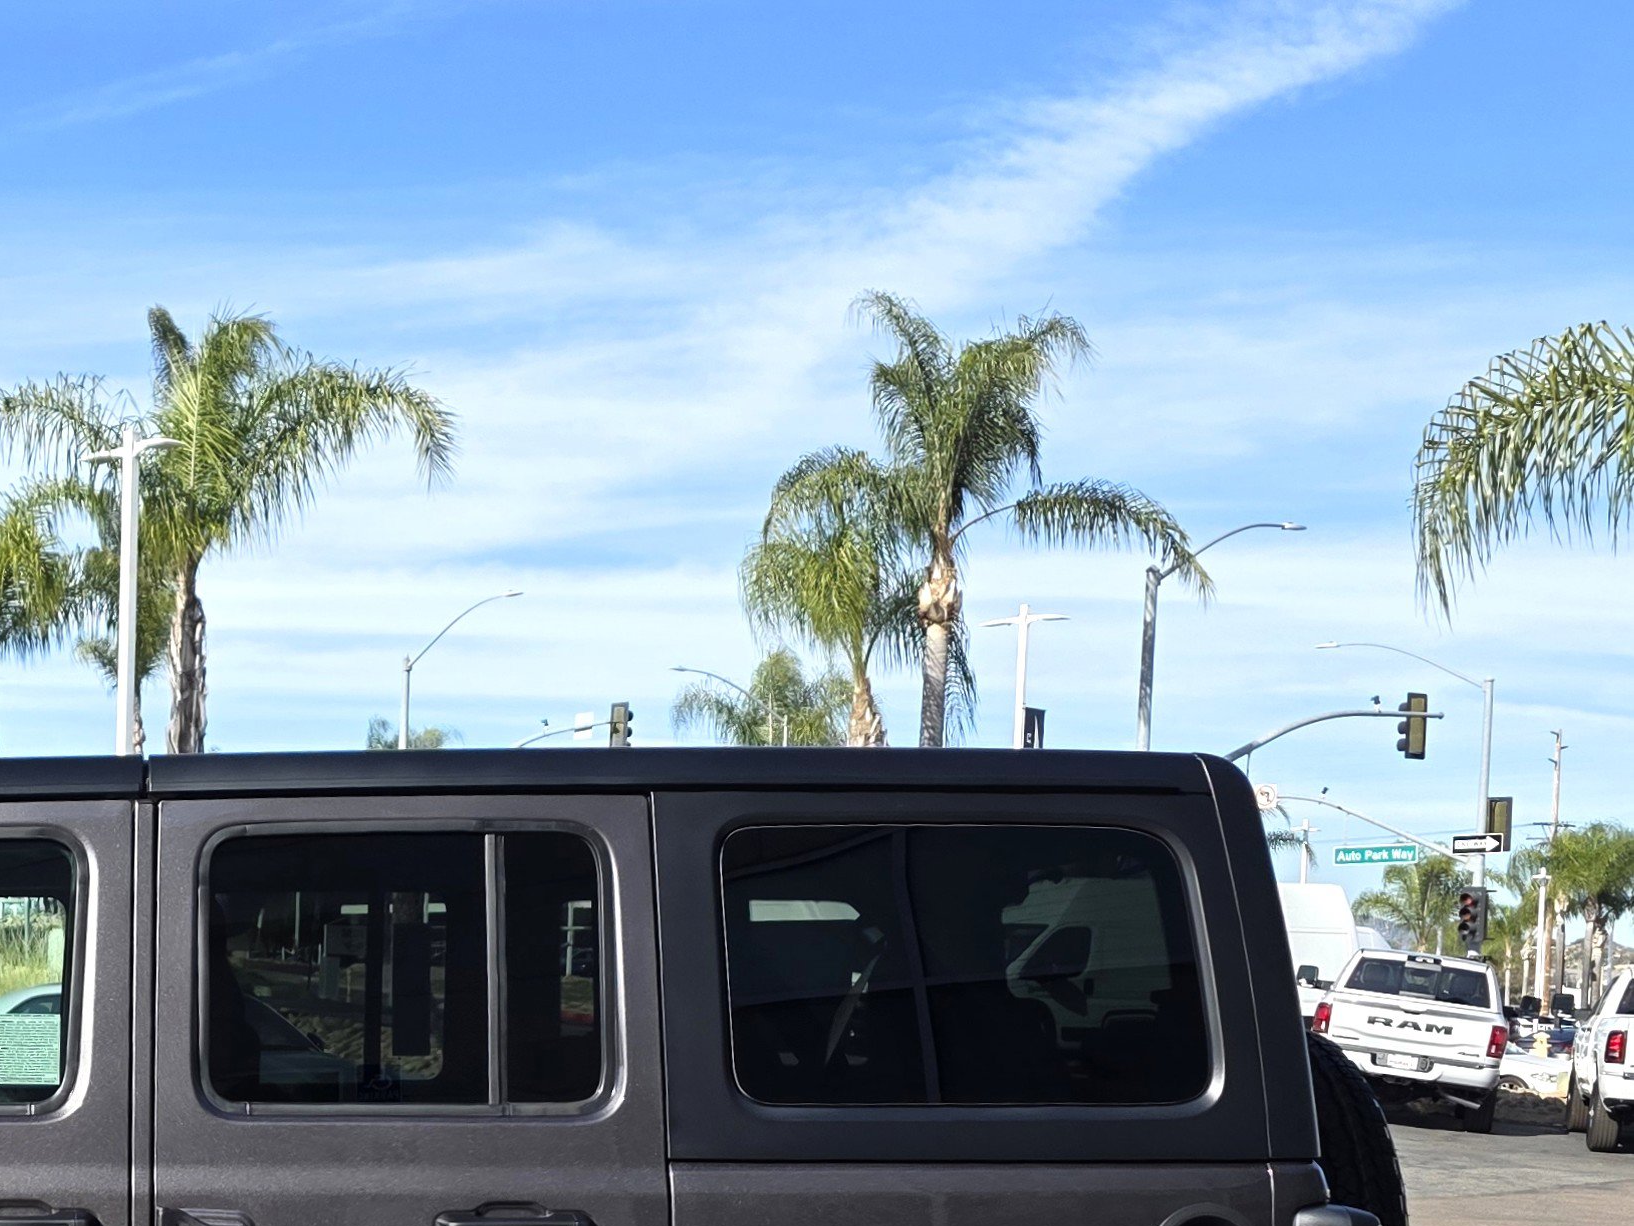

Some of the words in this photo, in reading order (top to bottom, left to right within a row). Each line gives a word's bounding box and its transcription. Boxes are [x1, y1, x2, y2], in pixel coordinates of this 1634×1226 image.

[1337, 850, 1361, 862] Auto
[1365, 850, 1389, 861] Park
[1392, 848, 1414, 861] Way
[1368, 1015, 1453, 1035] RAM
